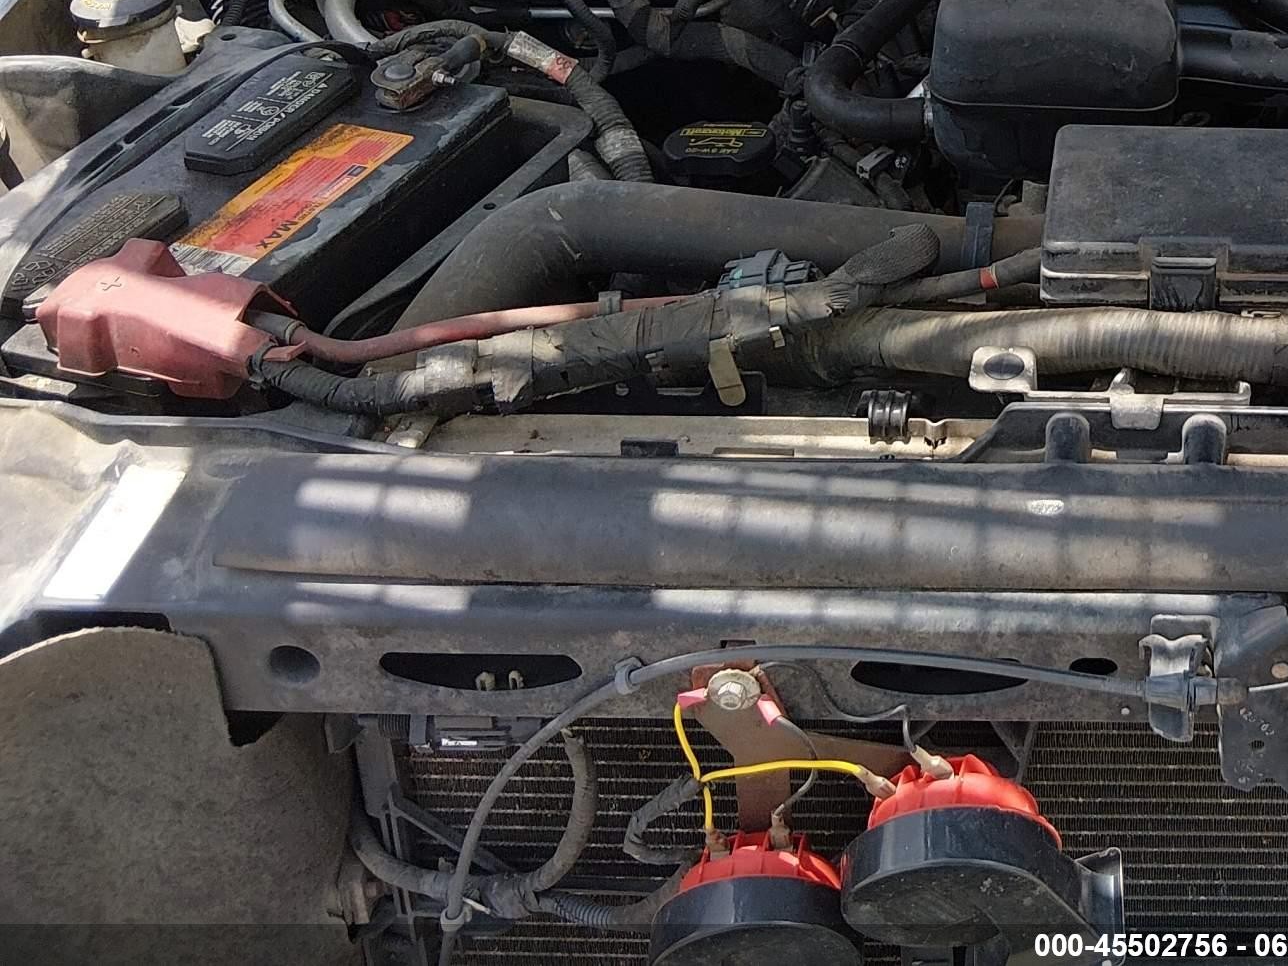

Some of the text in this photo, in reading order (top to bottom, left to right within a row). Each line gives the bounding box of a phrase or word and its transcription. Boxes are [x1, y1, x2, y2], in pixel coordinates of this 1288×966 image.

[284, 88, 322, 114] DANGER
[245, 117, 281, 141] POISON
[256, 219, 299, 250] MAX
